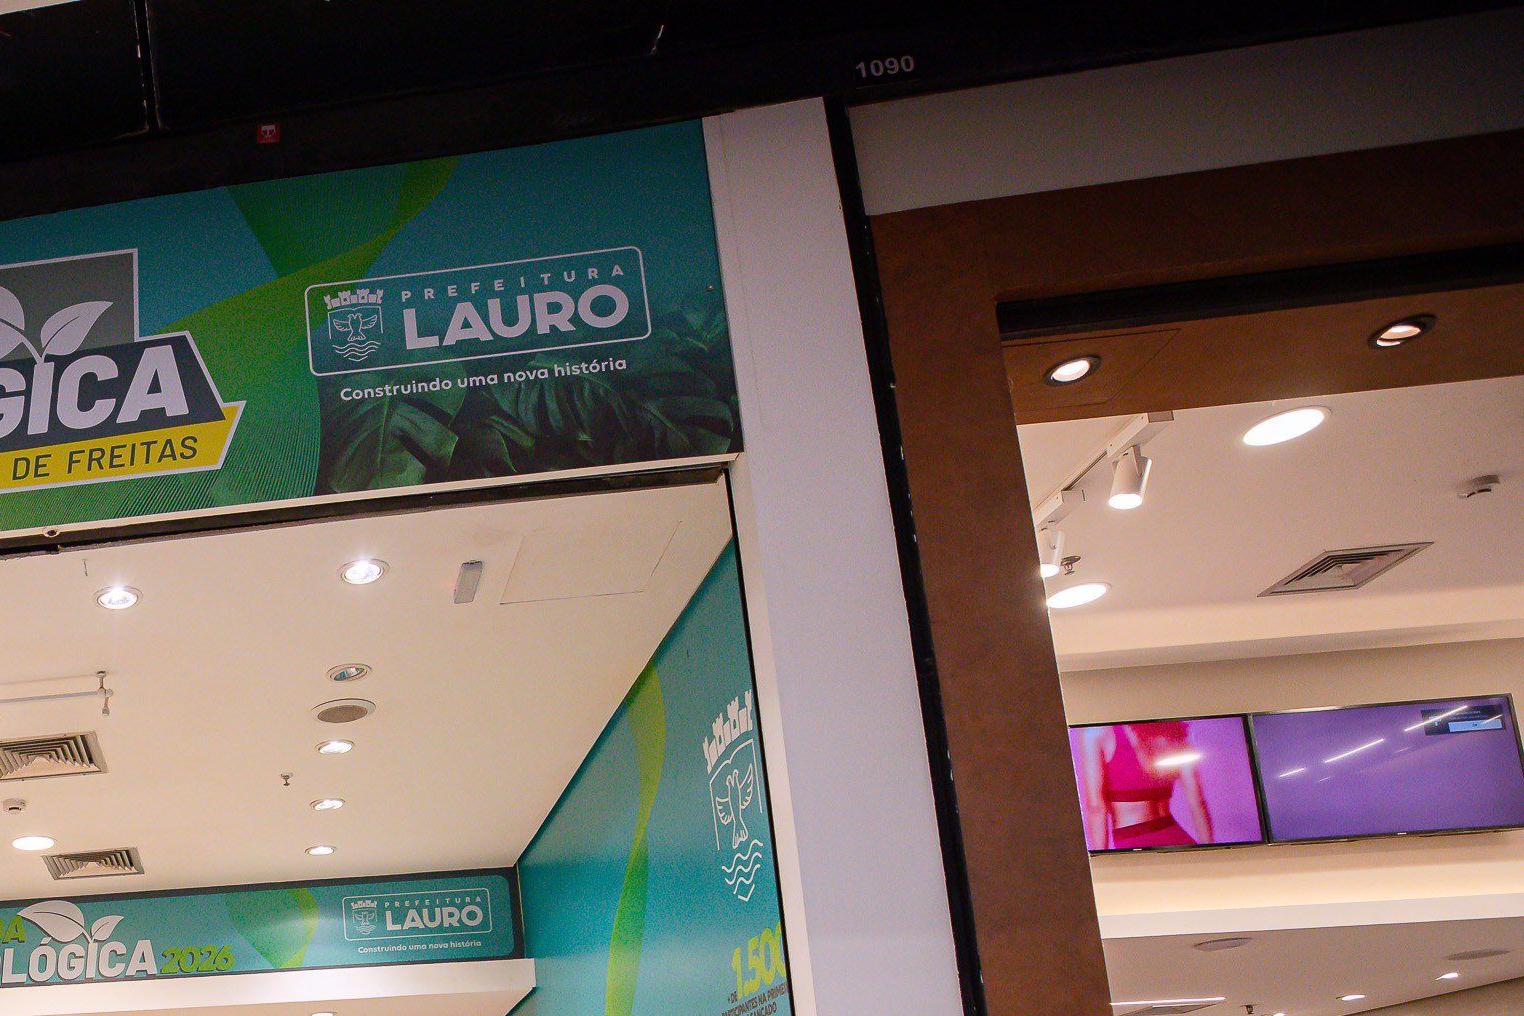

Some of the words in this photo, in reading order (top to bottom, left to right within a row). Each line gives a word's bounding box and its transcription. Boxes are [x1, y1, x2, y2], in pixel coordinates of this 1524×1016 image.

[855, 55, 915, 78] 1090
[401, 264, 625, 303] PREFEITURA
[402, 283, 630, 350] LAURO
[340, 377, 452, 401] Construindo
[457, 374, 498, 388] uma
[504, 368, 549, 384] nova
[554, 357, 627, 377] história
[12, 454, 52, 481] DE
[67, 435, 199, 474] FREITAS
[385, 896, 482, 908] PREFEITURA
[385, 904, 484, 931] LAURO
[161, 944, 236, 974] 2026
[357, 943, 407, 954] Construindo
[450, 940, 482, 948] história
[730, 991, 738, 1004] DE
